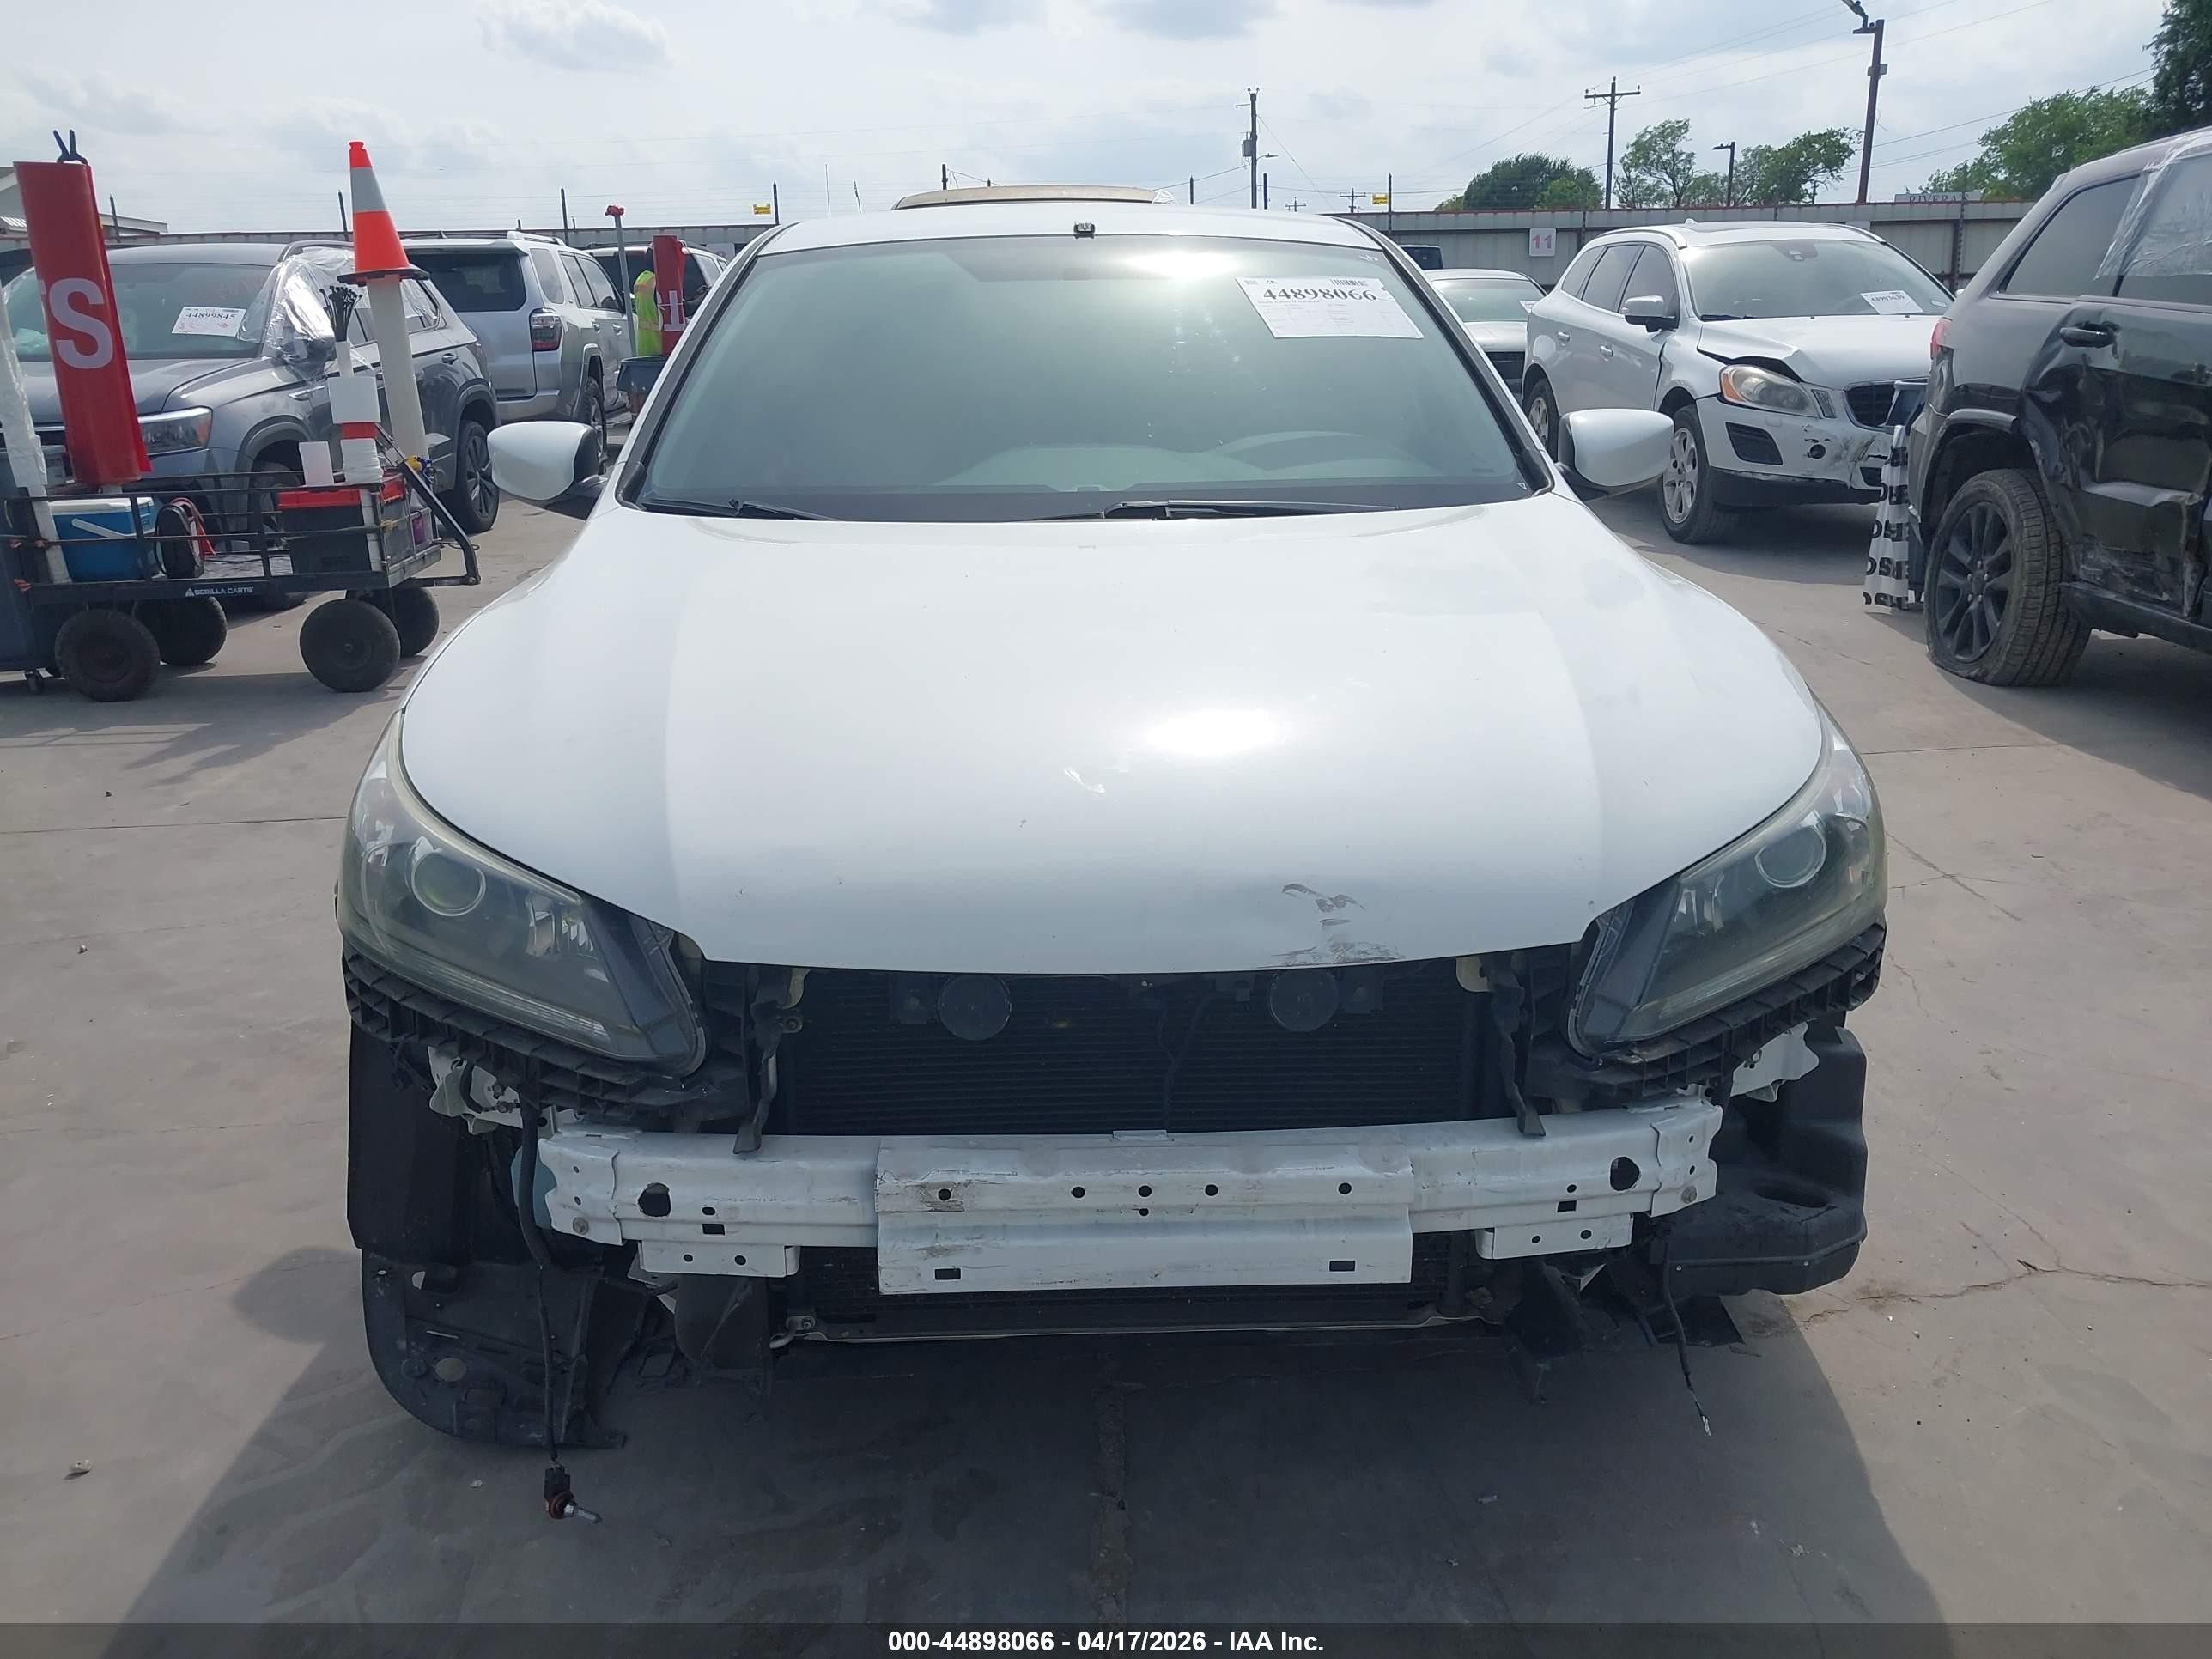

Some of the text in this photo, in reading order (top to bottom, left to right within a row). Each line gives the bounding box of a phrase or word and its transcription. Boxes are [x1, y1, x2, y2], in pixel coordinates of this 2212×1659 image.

[1532, 234, 1553, 249] 11
[1263, 289, 1376, 301] 44898066
[185, 312, 236, 320] 44899845
[194, 587, 226, 596] GORILLA
